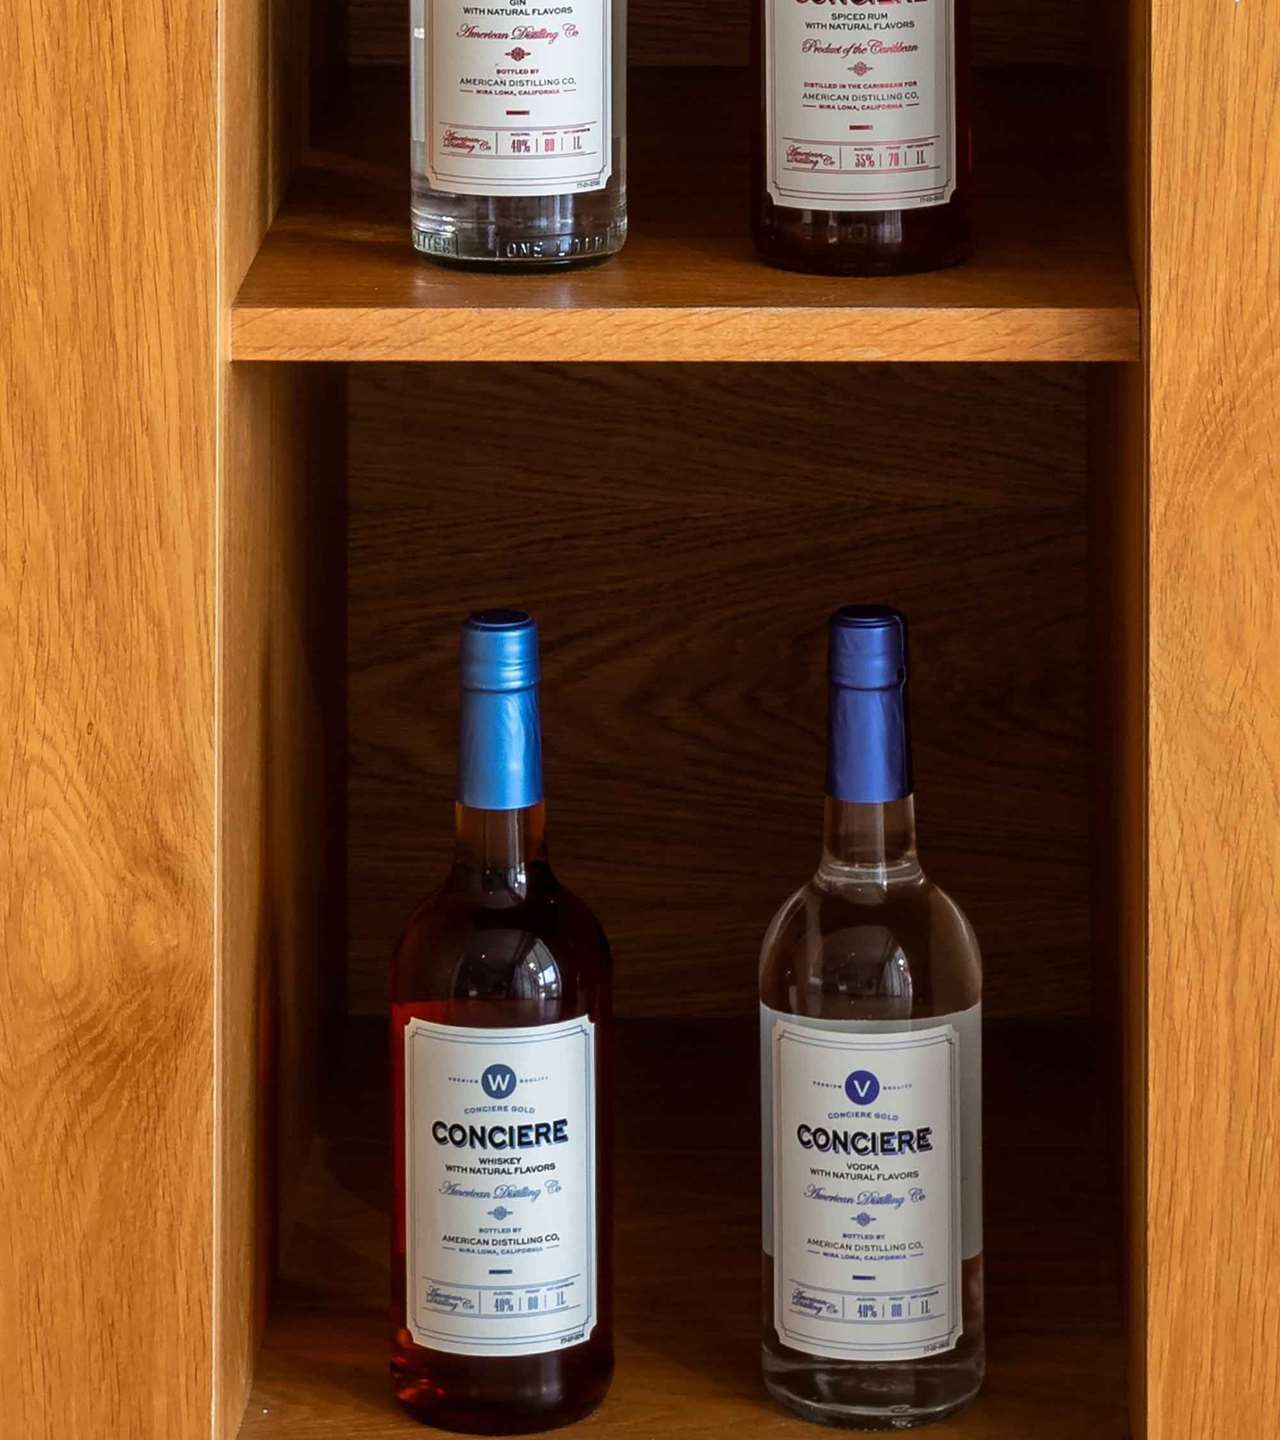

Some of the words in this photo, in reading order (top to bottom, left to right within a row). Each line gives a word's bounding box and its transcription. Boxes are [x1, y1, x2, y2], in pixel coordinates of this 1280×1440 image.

[463, 7, 485, 15] WITH
[487, 8, 530, 16] NATURAL
[532, 6, 573, 15] FLAVORS
[456, 23, 509, 39] American
[805, 22, 827, 30] WITH
[829, 22, 872, 31] NATURAL
[874, 21, 915, 30] FLAVORS
[460, 78, 506, 86] AMERICAN
[509, 79, 559, 87] DISTILLING
[802, 93, 849, 101] AMERICAN
[852, 93, 902, 101] DISTILLING
[855, 154, 875, 168] 35%
[889, 152, 899, 166] 70
[487, 1074, 510, 1091] W
[853, 1080, 870, 1098] V
[464, 1106, 508, 1114] CONCIERE
[511, 1106, 535, 1114] GOLD
[874, 1112, 898, 1121] GOLD
[432, 1119, 569, 1150] CONCIERE
[797, 1124, 933, 1156] CONCIERE
[478, 1157, 522, 1165] WHISKEY
[847, 1163, 880, 1171] VODKA
[445, 1164, 467, 1174] WITH
[469, 1167, 512, 1175] NATURAL
[514, 1163, 556, 1174] FLAVORS
[810, 1168, 831, 1177] WITH
[833, 1172, 875, 1181] NATURAL
[877, 1171, 919, 1181] FLAVORS
[804, 1184, 854, 1204] American
[442, 1235, 489, 1246] AMERICAN
[492, 1237, 543, 1246] DISTILLING
[807, 1238, 852, 1251] AMERICAN
[855, 1242, 906, 1252] DISTILLING
